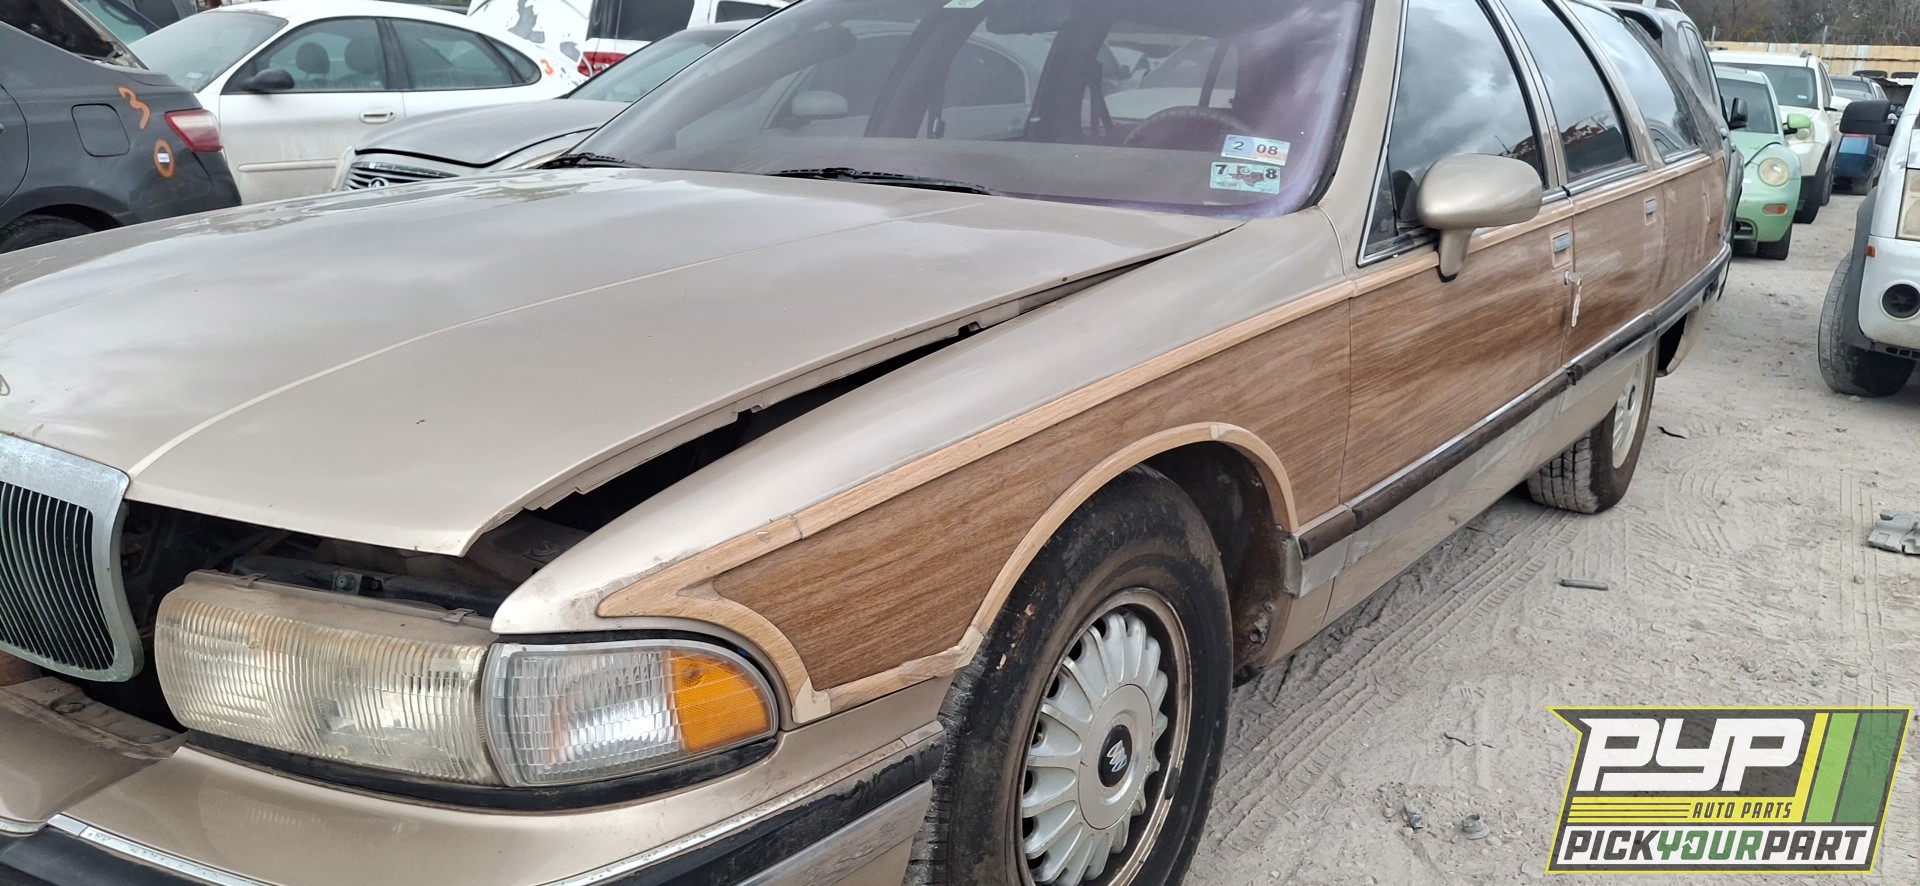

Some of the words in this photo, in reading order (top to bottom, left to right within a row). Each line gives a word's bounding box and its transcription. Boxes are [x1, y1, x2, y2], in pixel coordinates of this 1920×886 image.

[118, 86, 151, 130] 3
[1233, 141, 1244, 150] 2
[1256, 144, 1278, 155] 08
[1215, 164, 1227, 175] 7
[1265, 168, 1278, 179] 8
